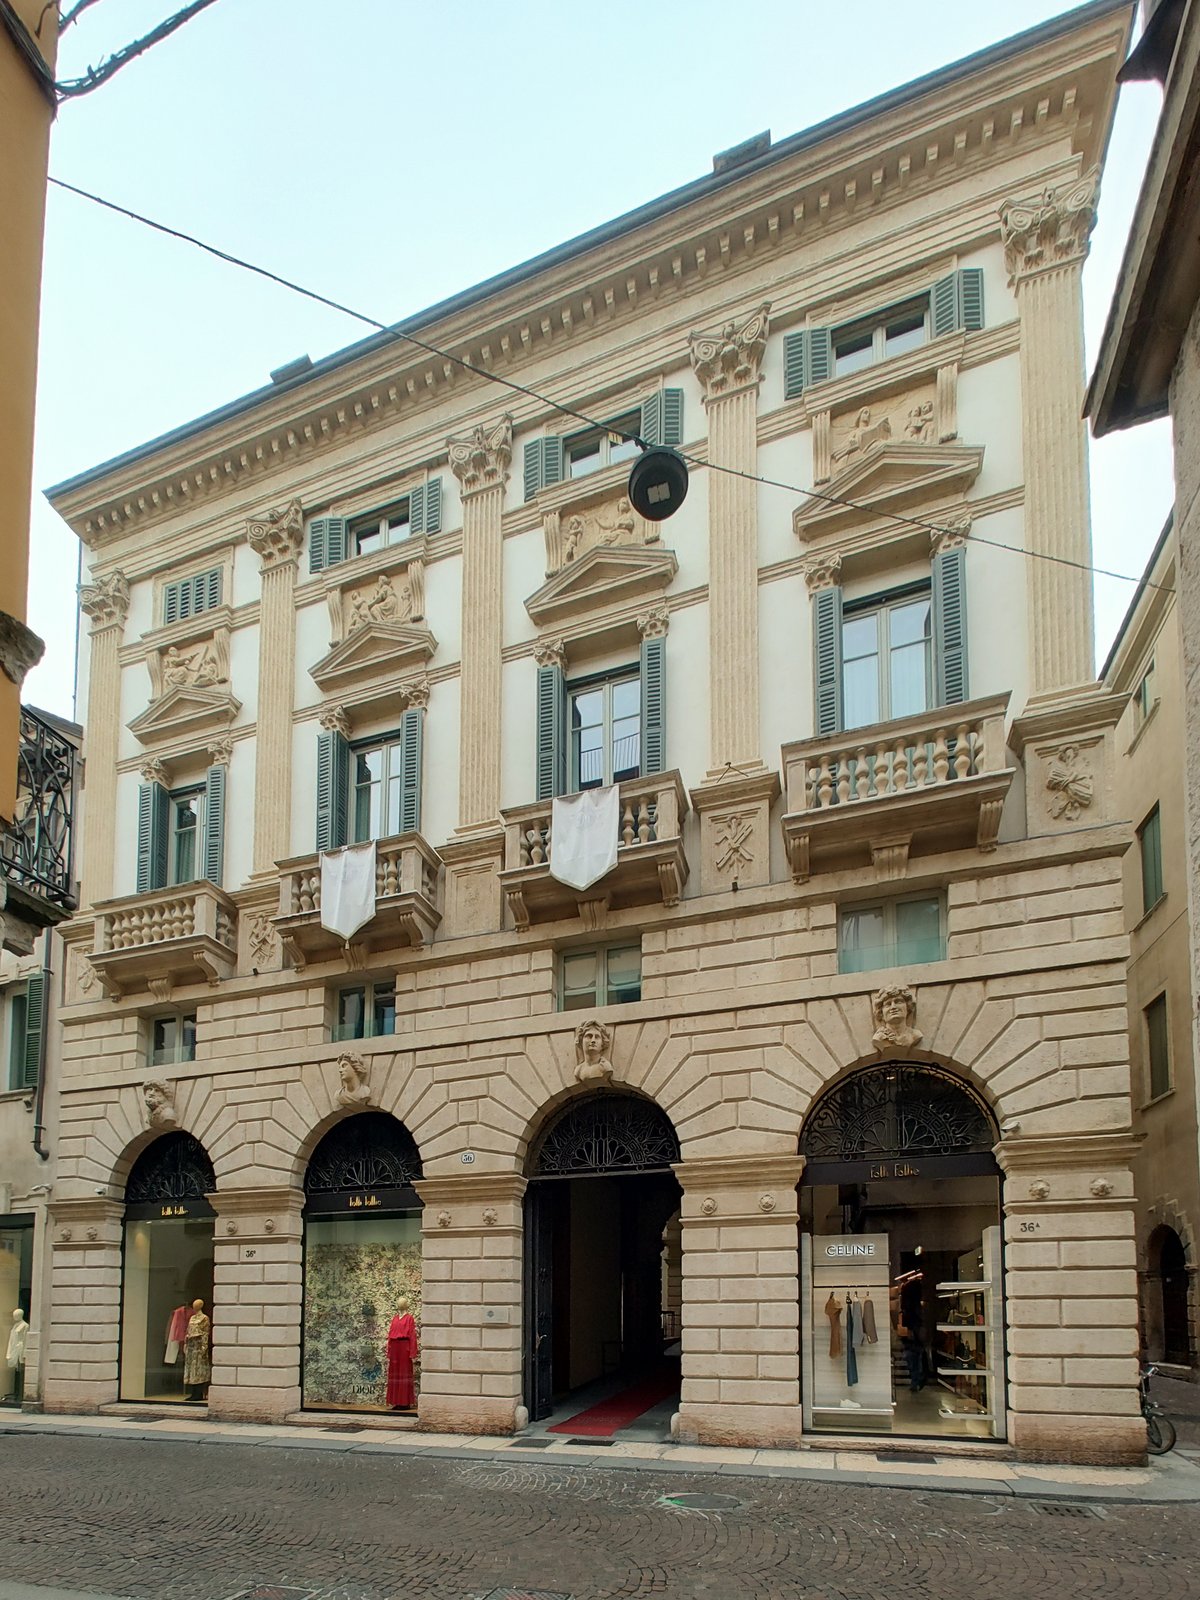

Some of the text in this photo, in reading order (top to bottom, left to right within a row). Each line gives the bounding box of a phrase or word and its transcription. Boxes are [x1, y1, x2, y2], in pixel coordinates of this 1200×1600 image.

[894, 1162, 920, 1177] Follie
[1020, 1222, 1041, 1233] 36A
[826, 1244, 874, 1256] CELINE
